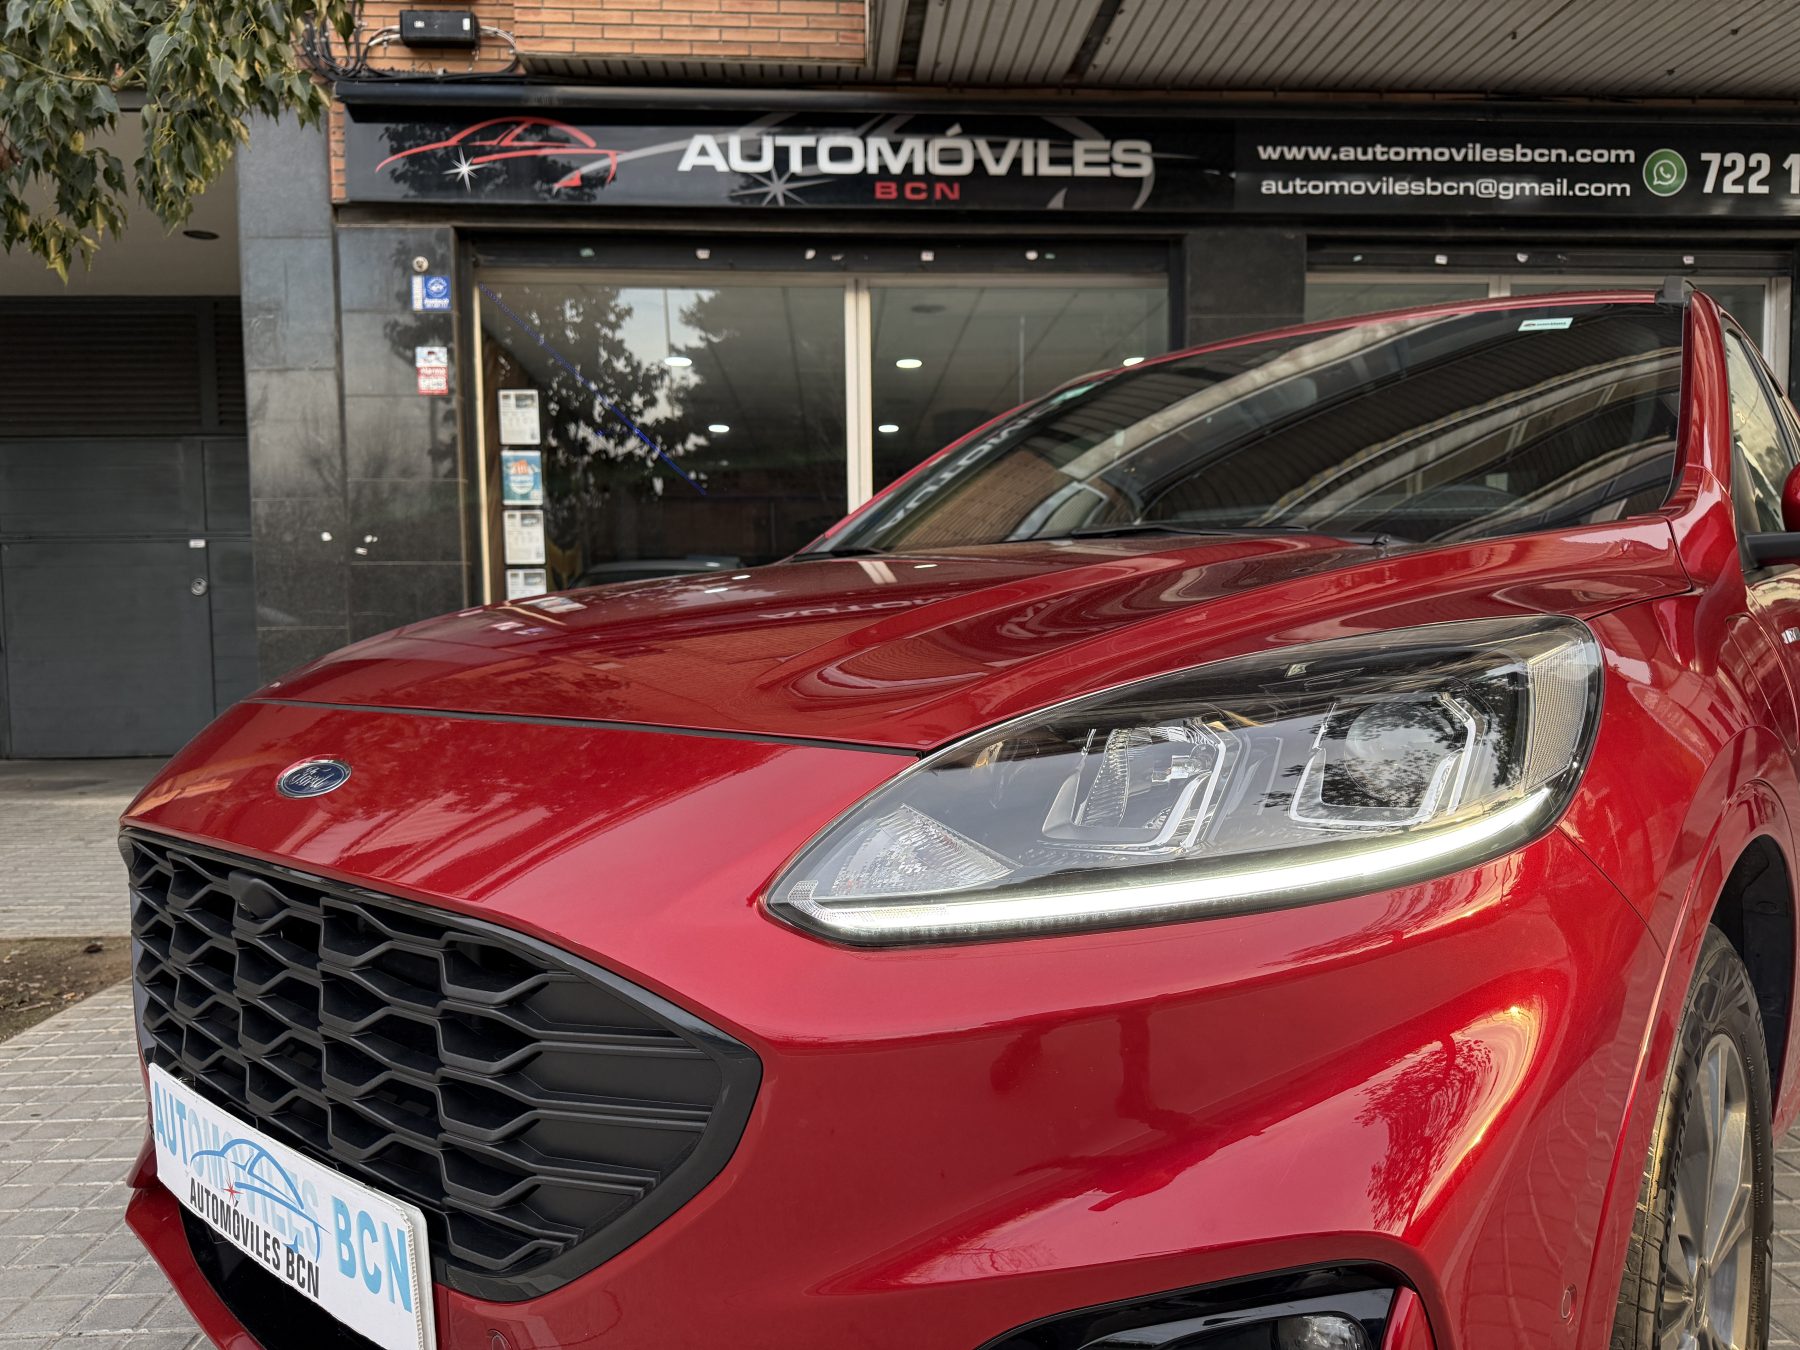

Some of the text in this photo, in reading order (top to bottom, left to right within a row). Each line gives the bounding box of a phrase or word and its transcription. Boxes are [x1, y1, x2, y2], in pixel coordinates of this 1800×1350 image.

[677, 123, 1153, 178] AUTOMÓVILES
[1257, 143, 1636, 163] www.automovilesbcn.com
[874, 181, 960, 200] BCN
[1261, 176, 1631, 199] automovilesbcn@gmail.com
[1700, 152, 1771, 194] 722
[190, 1177, 319, 1299] AUTOMÓVILES BCN
[332, 1196, 412, 1313] BCN
